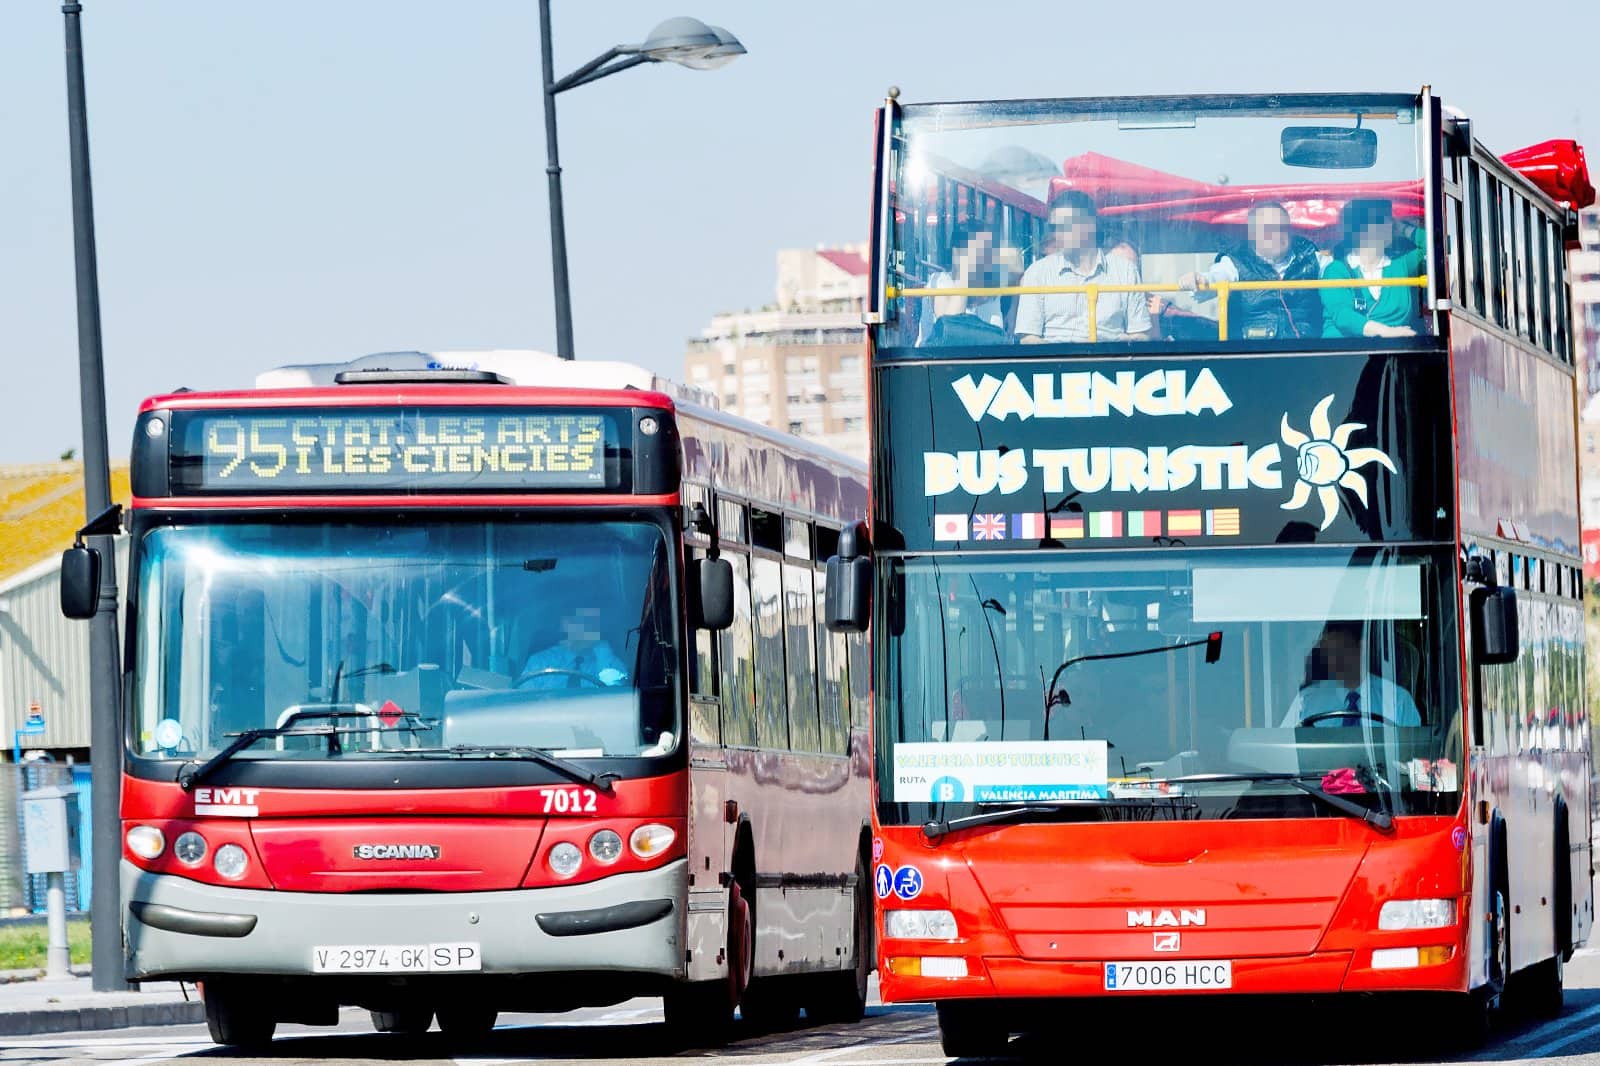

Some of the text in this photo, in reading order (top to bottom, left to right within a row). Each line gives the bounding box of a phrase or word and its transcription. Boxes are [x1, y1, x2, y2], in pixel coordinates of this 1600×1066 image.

[951, 367, 1234, 422] VALENCIA
[208, 419, 287, 478] 95
[417, 417, 485, 445] LES
[498, 416, 601, 444] ARTS
[323, 447, 392, 474] LES
[403, 445, 594, 473] CIENCIES
[923, 442, 1283, 497] BUS TURISTIC
[899, 776, 927, 785] RUTA
[194, 787, 259, 805] EMT
[940, 783, 955, 800] B
[980, 790, 1037, 801] VALENCIA
[540, 790, 597, 813] 7012
[358, 846, 435, 859] SCANIA
[1126, 909, 1206, 928] MAN
[1121, 965, 1226, 985] 7006 HCC
